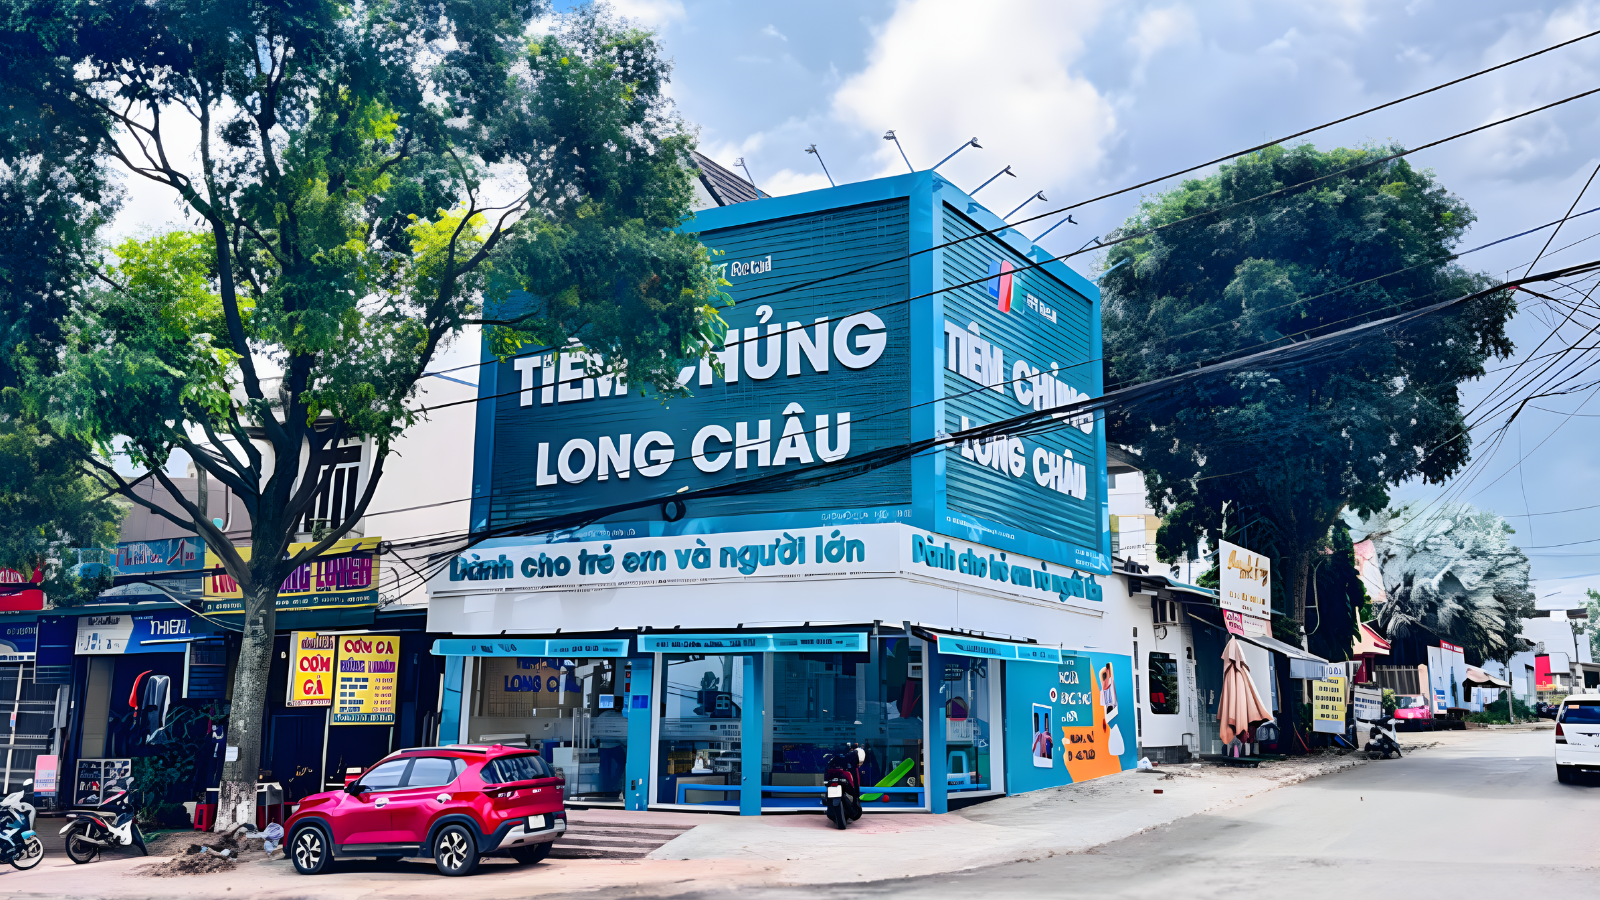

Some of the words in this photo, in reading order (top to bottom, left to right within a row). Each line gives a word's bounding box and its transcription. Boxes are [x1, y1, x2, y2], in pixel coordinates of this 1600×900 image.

[536, 431, 675, 487] LONG
[691, 402, 851, 474] CHÂU
[1032, 447, 1087, 501] CHÂU
[520, 552, 572, 578] cho
[674, 537, 712, 570] và
[719, 531, 806, 576] người
[815, 529, 866, 564] lớn
